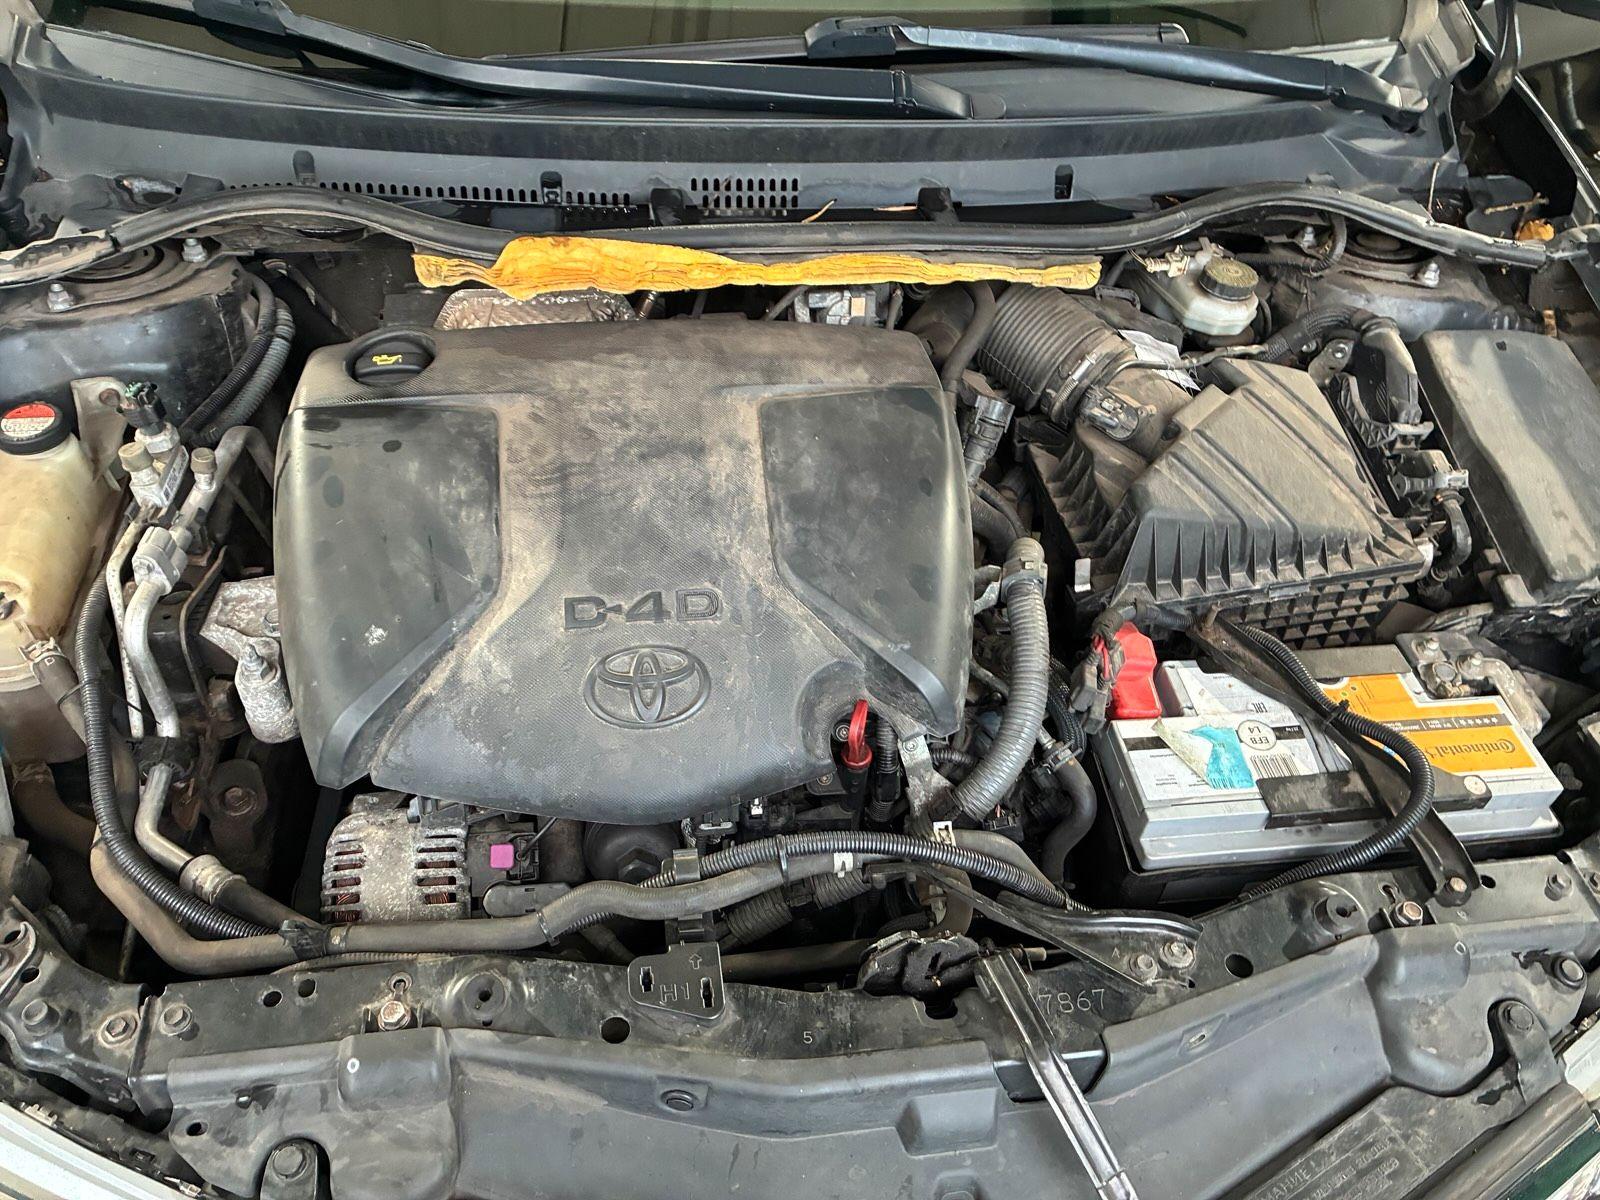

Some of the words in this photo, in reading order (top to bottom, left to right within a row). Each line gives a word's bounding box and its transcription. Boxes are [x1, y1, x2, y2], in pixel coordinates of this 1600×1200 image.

[564, 588, 720, 630] D-4D
[1247, 725, 1262, 735] L4
[1249, 736, 1270, 745] EFB
[1435, 738, 1516, 759] Continental
[1038, 988, 1105, 1015] 7867
[802, 1031, 813, 1045] 5
